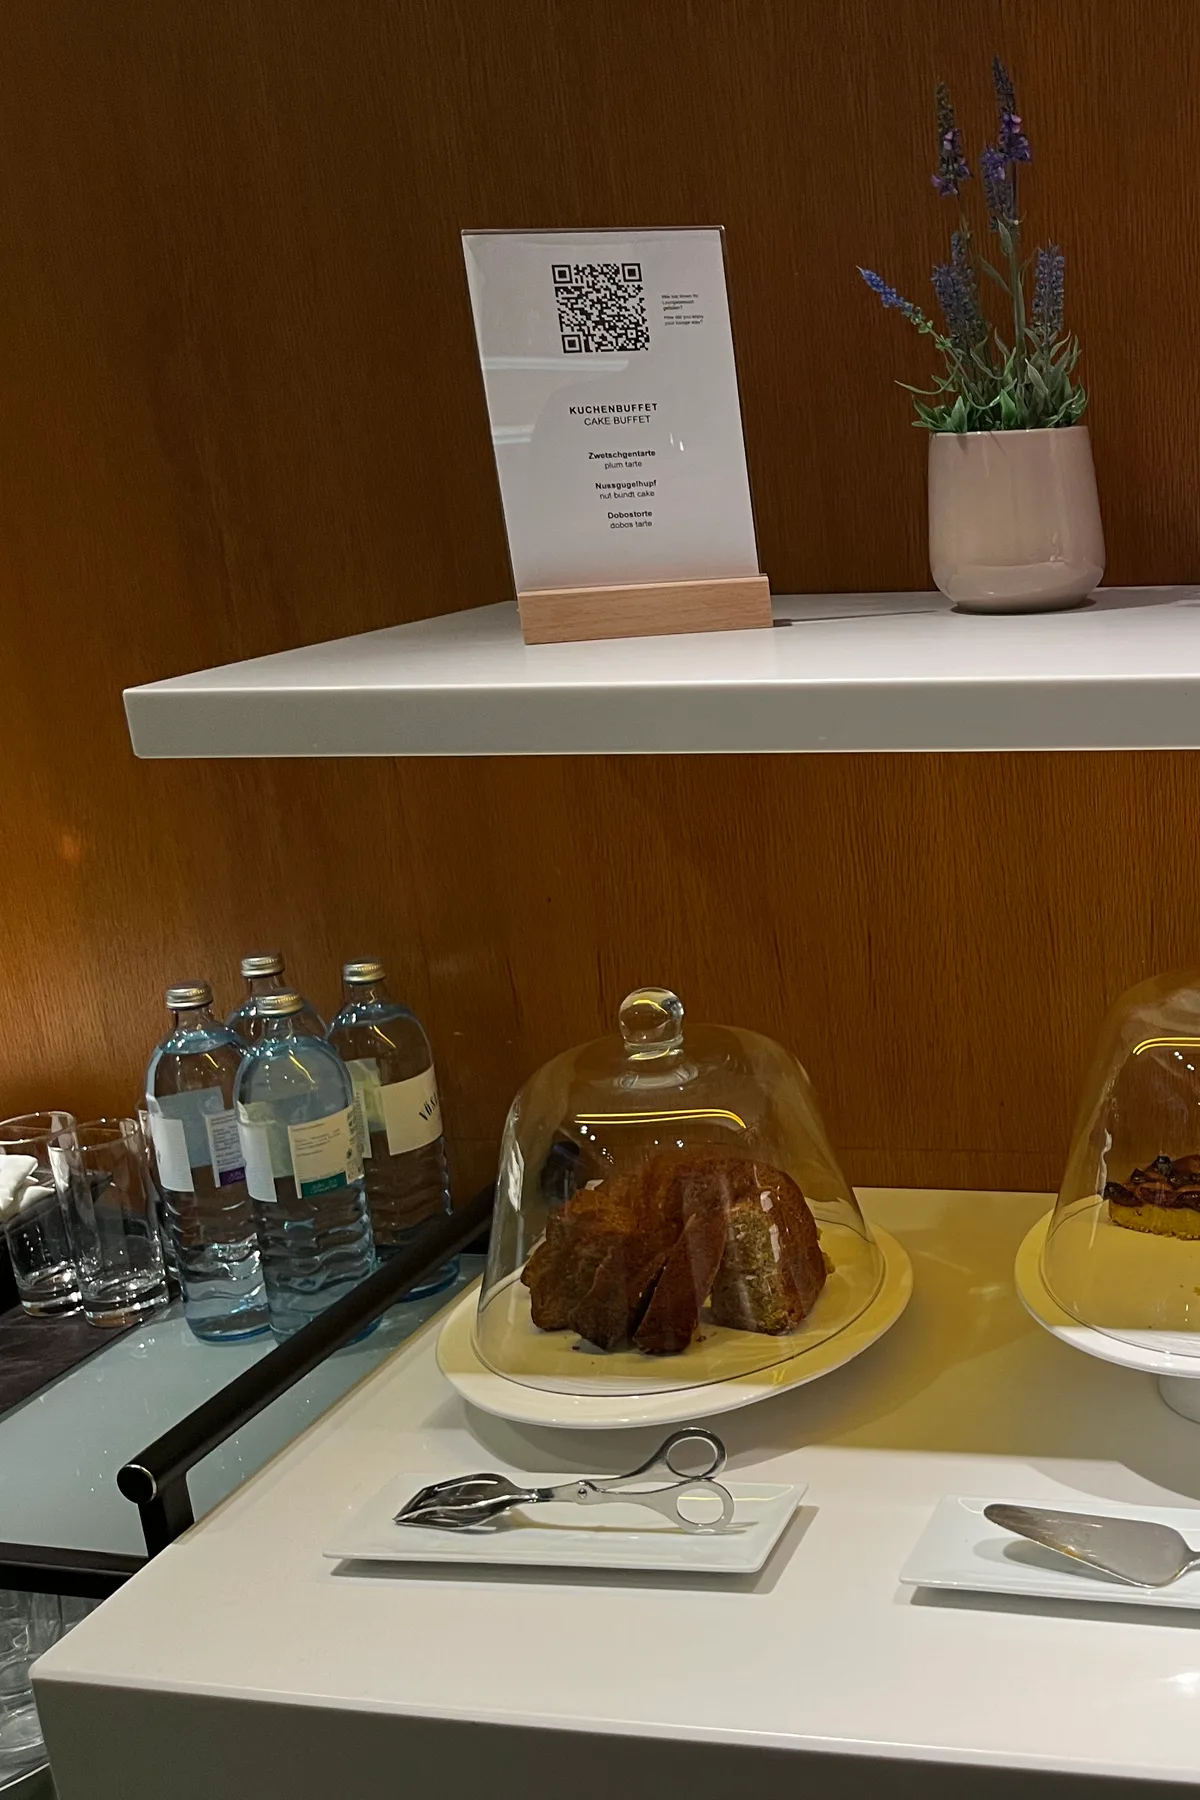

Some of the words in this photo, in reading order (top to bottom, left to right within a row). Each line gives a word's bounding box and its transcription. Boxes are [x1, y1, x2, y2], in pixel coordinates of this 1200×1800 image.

[569, 403, 658, 414] KUCHENBUFFET
[584, 416, 611, 426] CAKE
[613, 415, 651, 425] BUFFET
[588, 450, 656, 460] Zwetschgentarte
[604, 462, 623, 470] plum
[625, 460, 642, 468] tarte
[595, 479, 657, 490] Nussgugelhupf
[599, 492, 612, 500] nut
[613, 491, 635, 499] bundt
[637, 490, 655, 498] cake
[607, 510, 653, 519] Dobostorte
[610, 521, 633, 529] dobos
[635, 520, 652, 528] tarte
